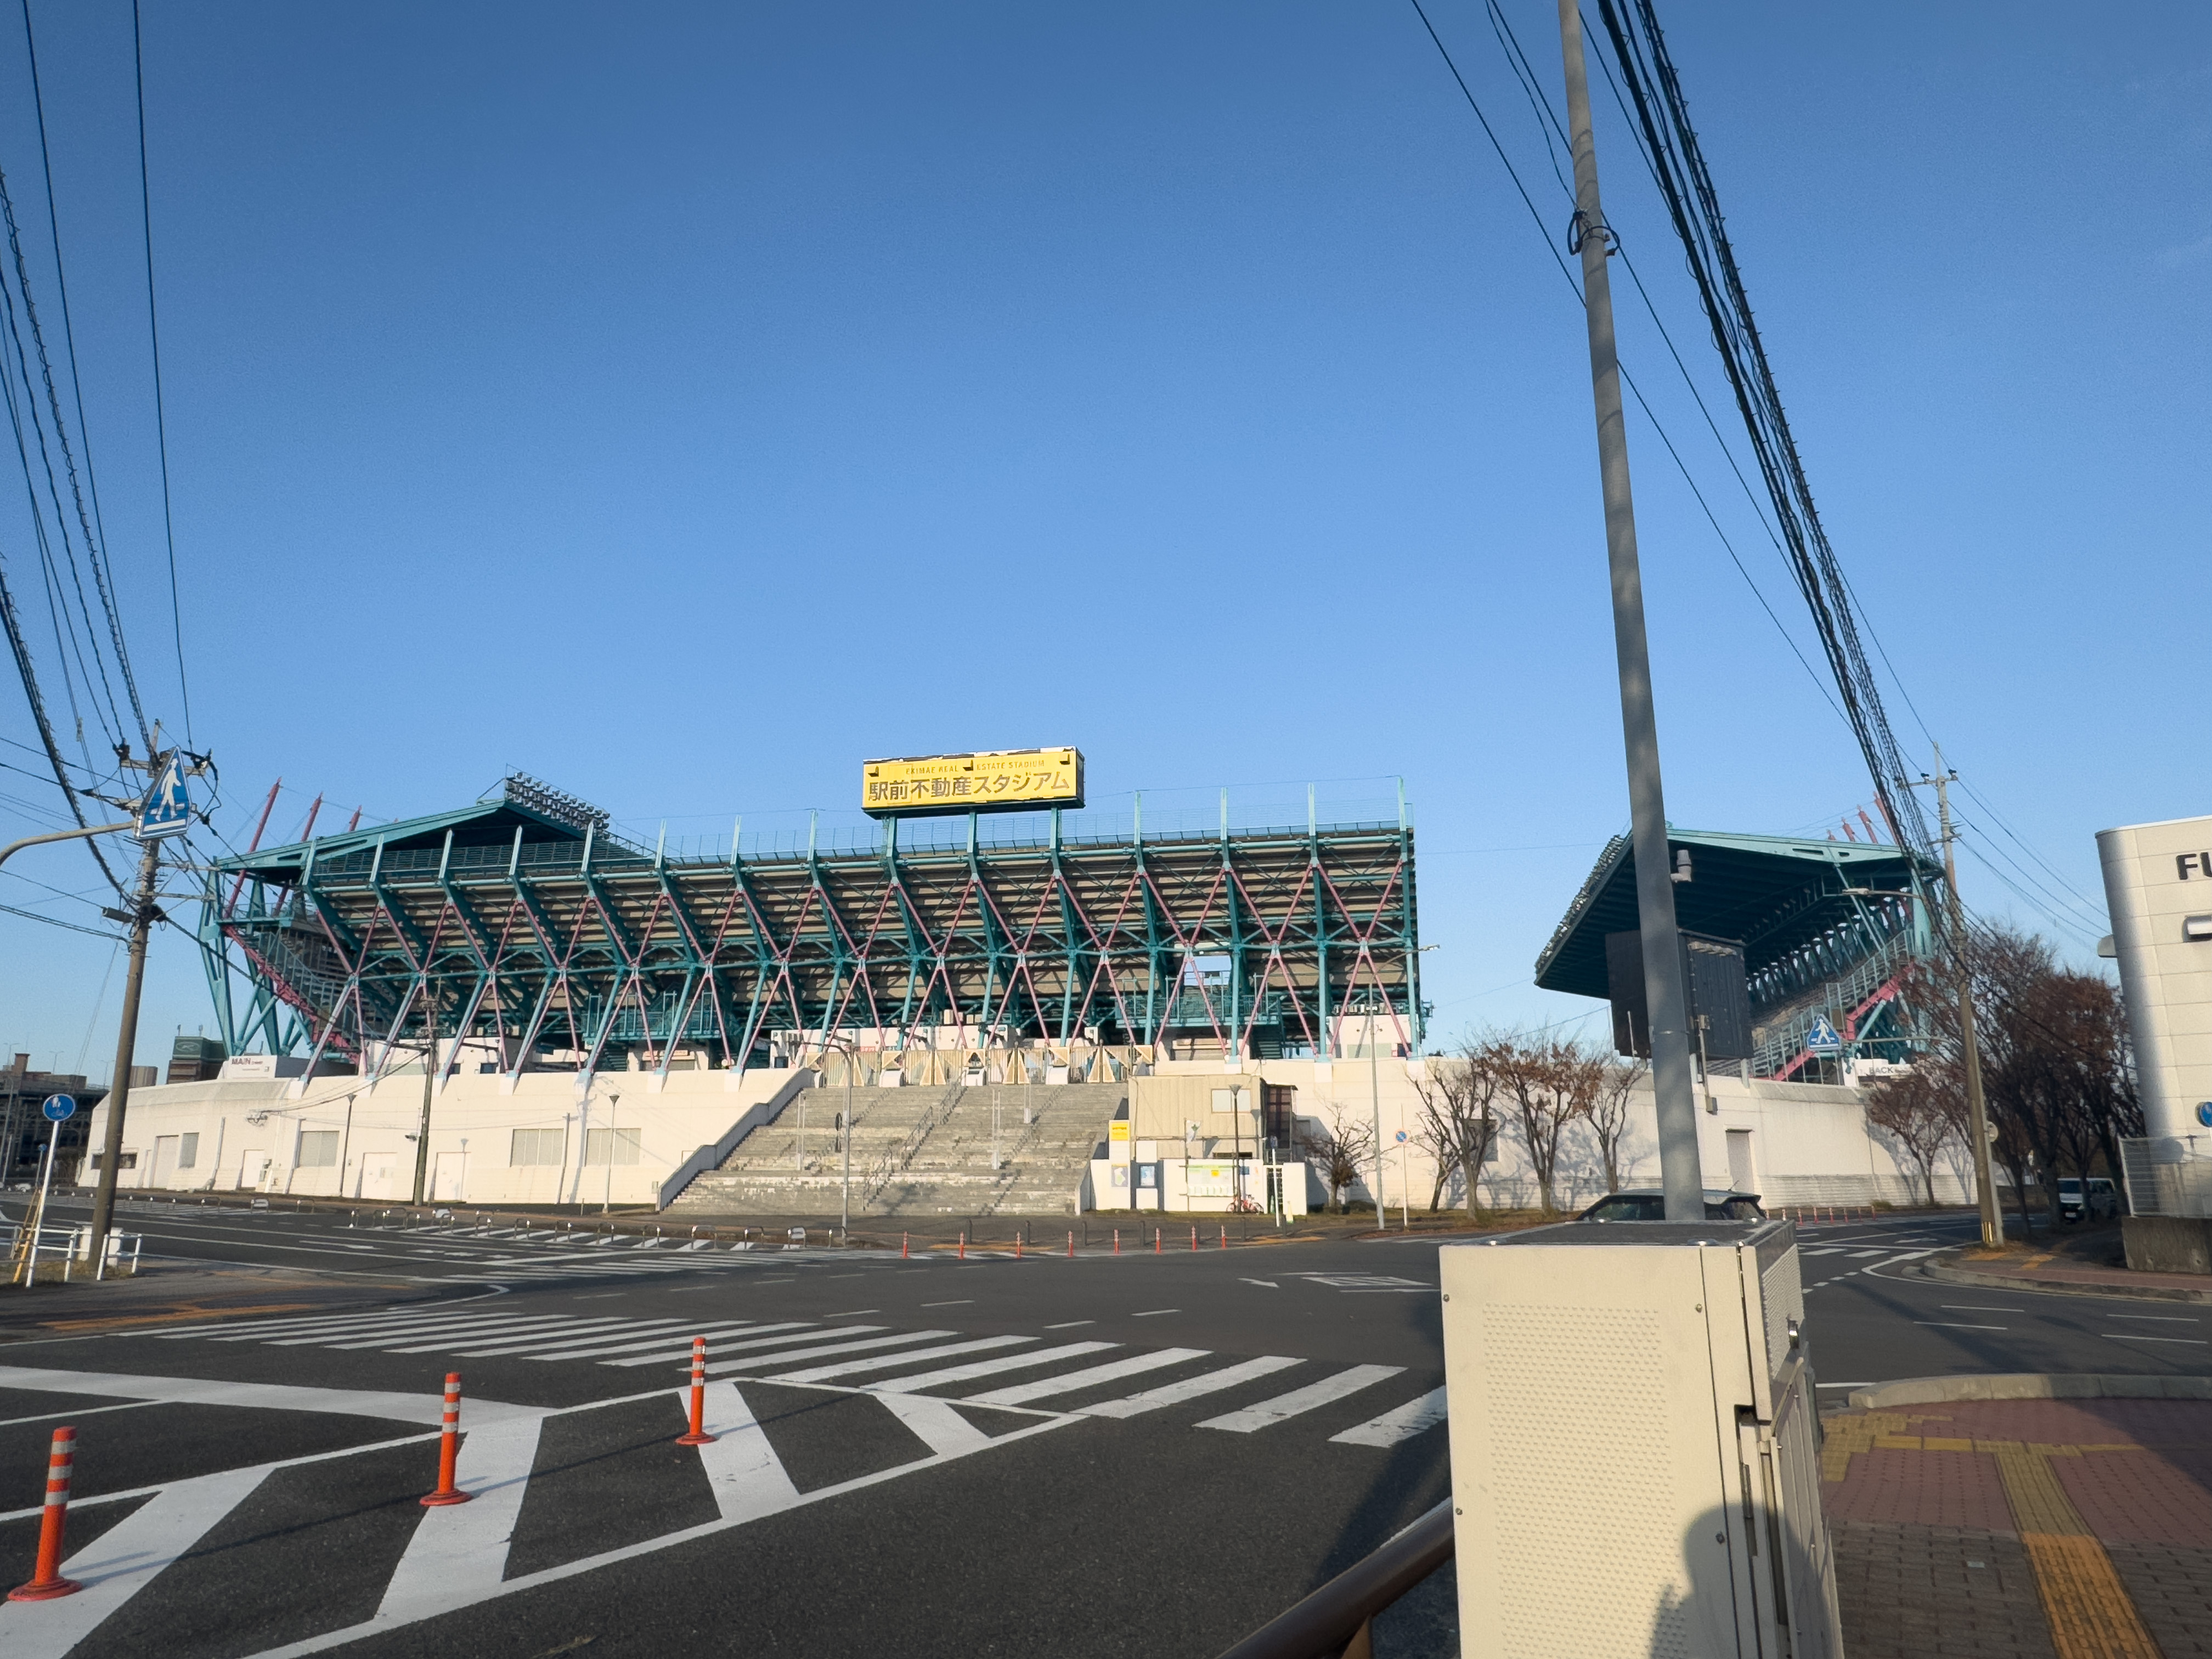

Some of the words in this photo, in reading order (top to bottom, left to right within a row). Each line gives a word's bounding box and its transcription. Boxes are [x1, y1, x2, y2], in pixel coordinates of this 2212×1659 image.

[977, 762, 1005, 770] ESTATE
[1008, 760, 1045, 768] STADIUM
[868, 771, 1070, 801] 駅前不動産スタジアム
